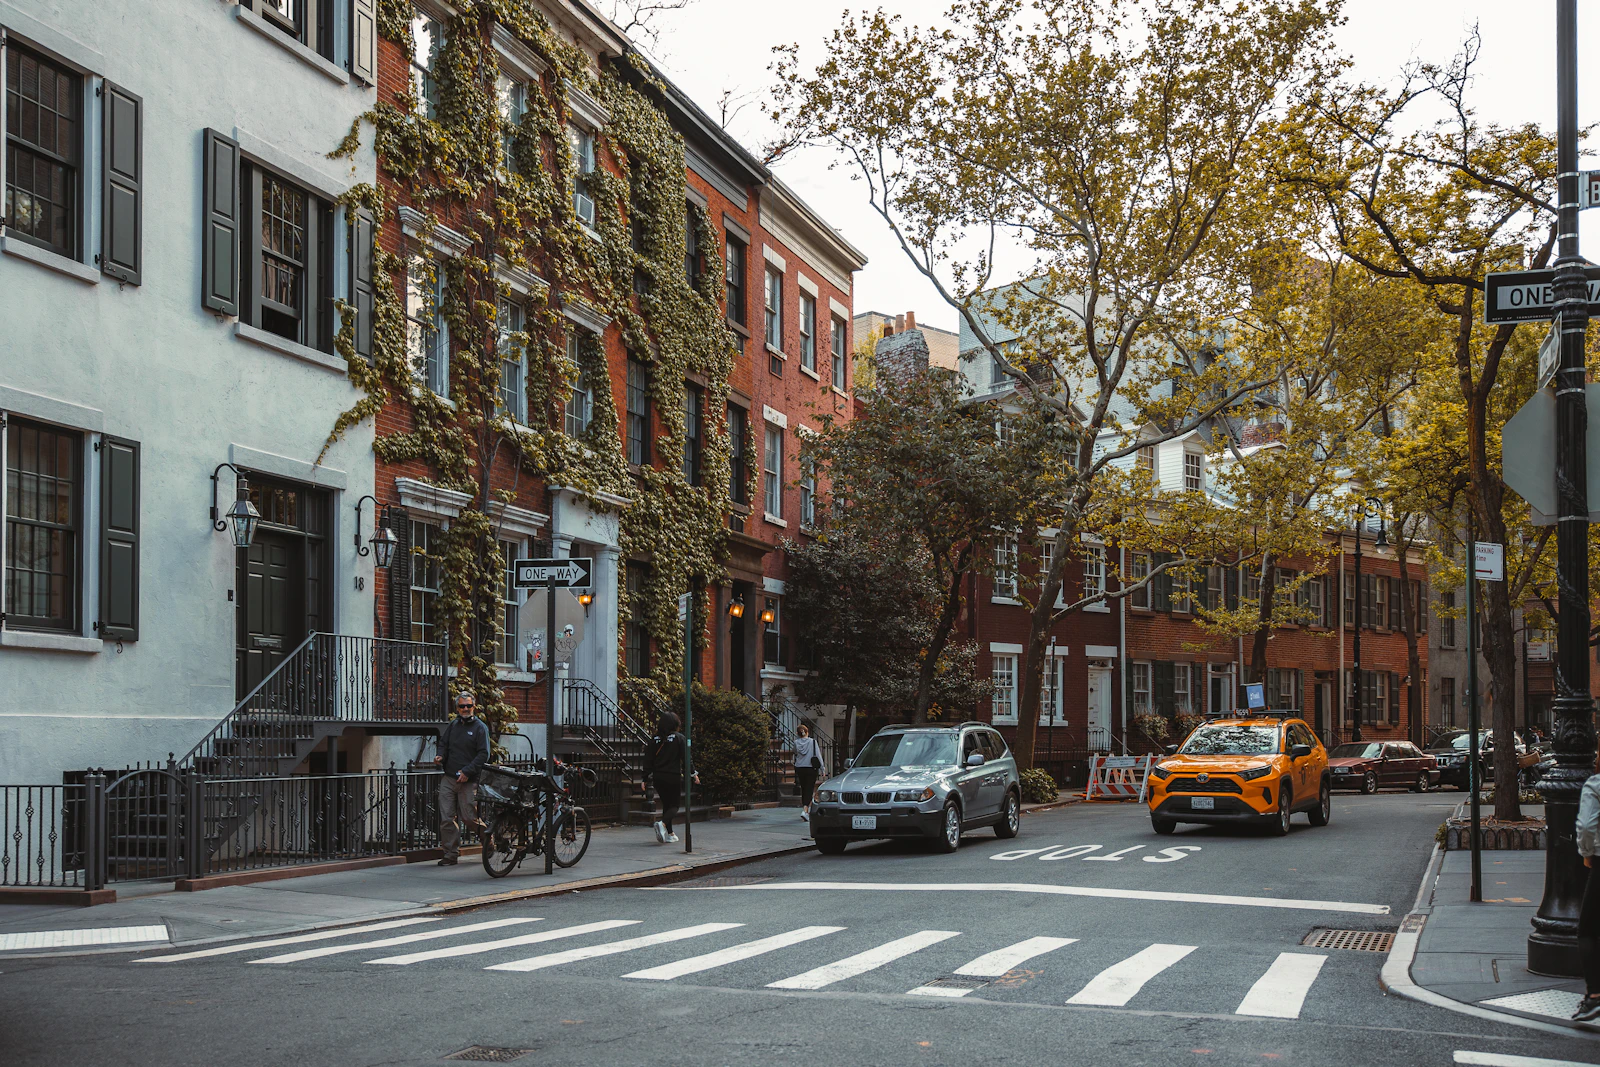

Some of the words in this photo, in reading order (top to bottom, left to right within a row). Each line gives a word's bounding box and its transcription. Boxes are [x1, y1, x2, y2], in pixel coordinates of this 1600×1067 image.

[1510, 287, 1554, 306] ONE
[1475, 546, 1495, 554] PARKING
[525, 568, 547, 580] ONE
[556, 568, 579, 579] WAY
[354, 576, 365, 591] 18
[989, 844, 1202, 863] STOP
